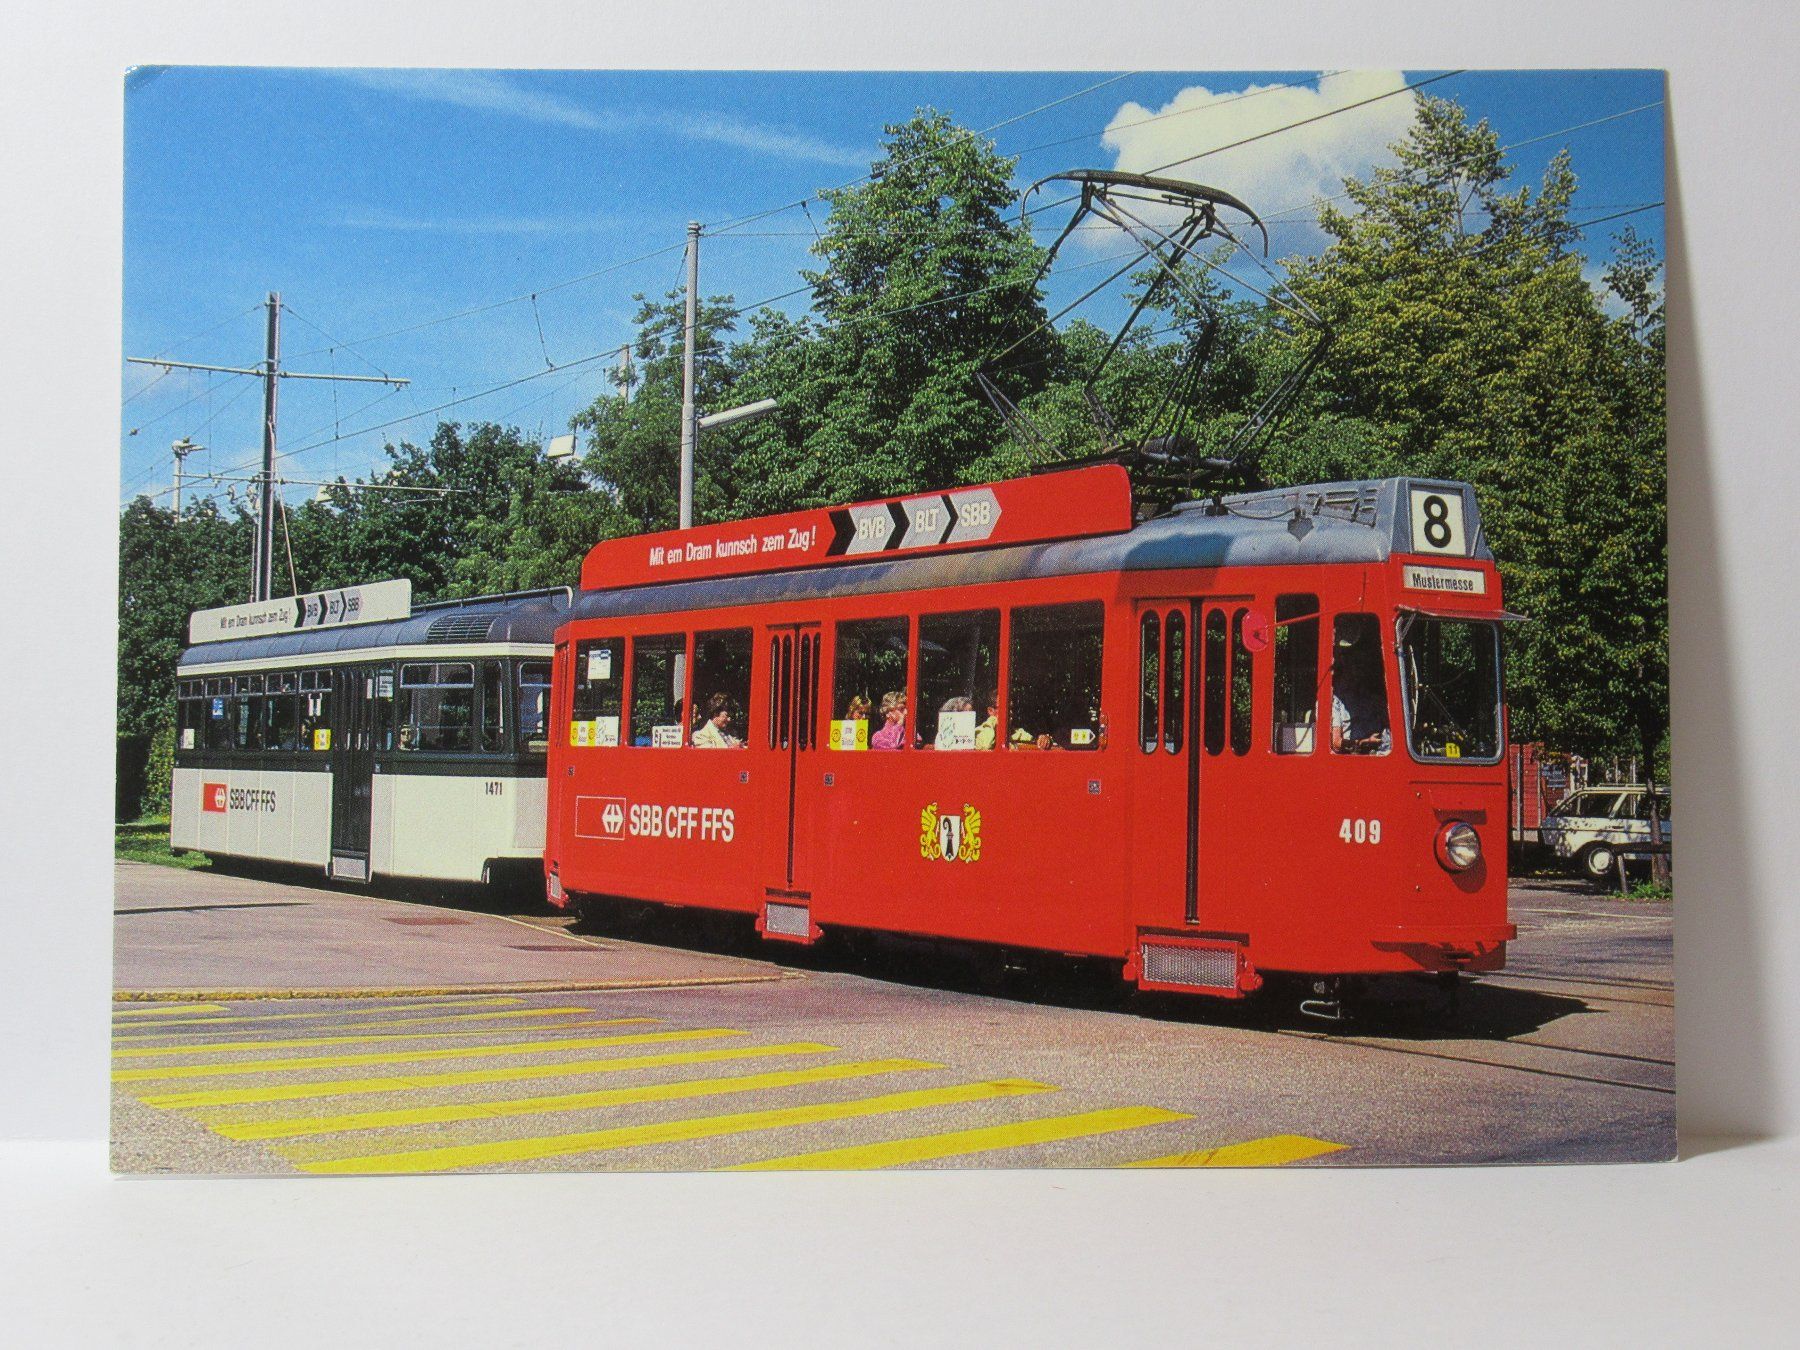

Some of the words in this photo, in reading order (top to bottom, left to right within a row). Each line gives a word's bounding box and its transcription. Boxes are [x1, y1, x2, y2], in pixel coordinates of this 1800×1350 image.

[858, 516, 886, 540] BVB
[915, 508, 939, 533] BLT
[960, 501, 991, 527] SBB
[1423, 495, 1452, 549] 8
[649, 547, 665, 566] Mit
[667, 549, 682, 565] em
[685, 542, 712, 562] Dram
[715, 534, 757, 559] kunnsch
[762, 535, 785, 552] zem
[1412, 573, 1474, 591] Mustermesse
[230, 788, 245, 810] SBB
[245, 788, 259, 811] CFF
[261, 789, 276, 813] FFS
[485, 781, 503, 796] 1471
[629, 803, 663, 837] SBB
[665, 805, 699, 840] CFF
[701, 807, 735, 843] FFS
[1339, 818, 1381, 845] 409
